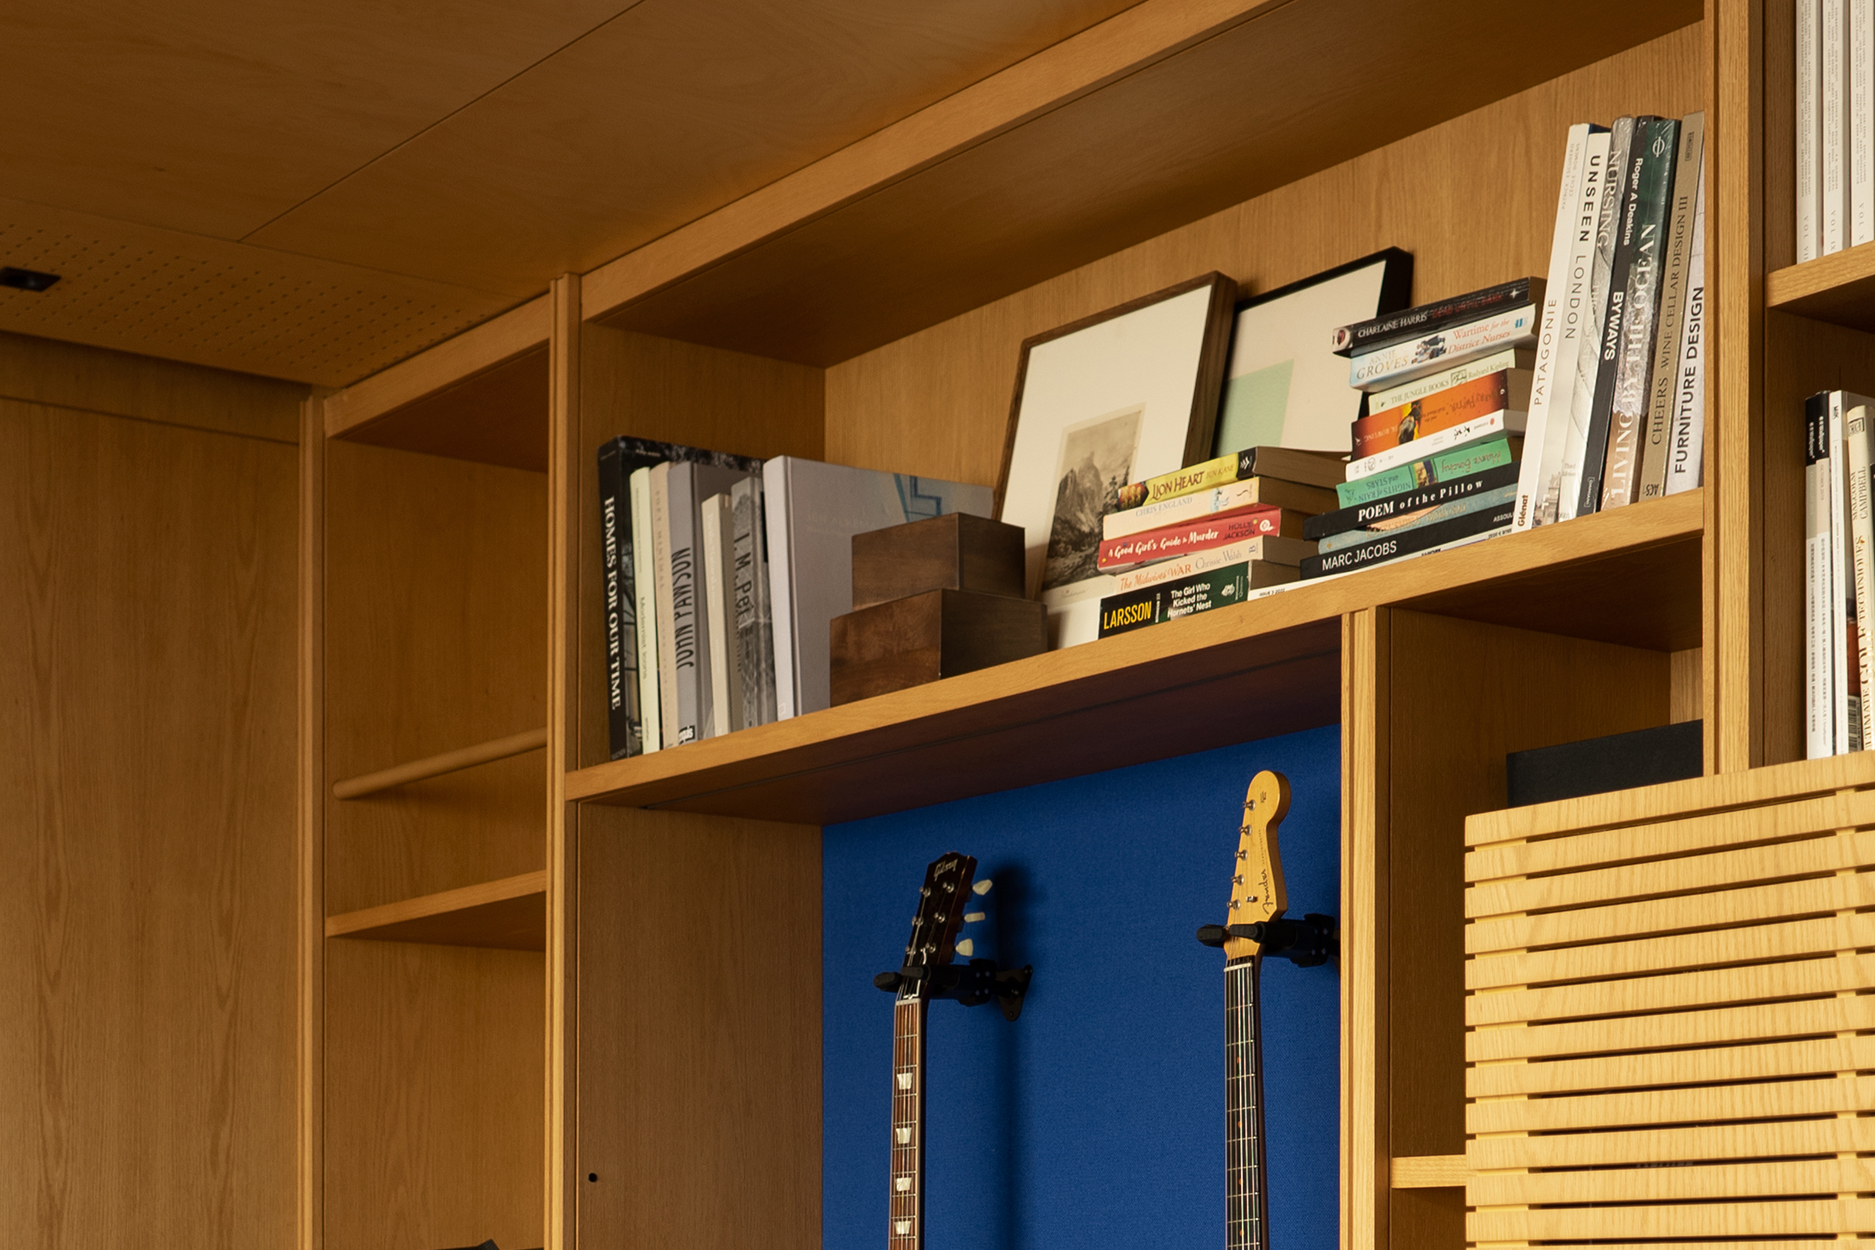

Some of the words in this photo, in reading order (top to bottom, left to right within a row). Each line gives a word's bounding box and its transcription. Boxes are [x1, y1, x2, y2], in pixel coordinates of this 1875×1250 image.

[1631, 158, 1643, 190] Roger
[1579, 155, 1601, 242] UNSEEN
[1597, 150, 1622, 247] NURSING
[1630, 192, 1638, 200] A
[1678, 196, 1688, 210] III
[1623, 203, 1637, 246] Deakins
[1672, 214, 1686, 267] DESIGN
[1565, 255, 1587, 339] LONDON
[1665, 271, 1679, 328] CELLAR
[1357, 318, 1399, 338] CHARLAINE
[1400, 312, 1427, 329] HARRIS
[1448, 338, 1481, 354] District
[1481, 330, 1511, 345] Nurses
[1452, 323, 1490, 340] Wartime
[1490, 321, 1500, 332] for
[1501, 318, 1511, 328] the
[1604, 291, 1624, 361] BYWAYS
[1356, 355, 1409, 380] GROVES
[1369, 350, 1397, 366] ANNIE
[1534, 299, 1558, 406] PATAGONIE
[1611, 412, 1635, 498] LIVING
[1633, 224, 1657, 309] OCEAN
[1660, 331, 1674, 369] WINE
[1390, 394, 1404, 404] THE
[1404, 386, 1427, 402] JUNGLE
[1427, 379, 1450, 395] BOOKS
[1468, 366, 1490, 380] Rudyard
[1490, 360, 1511, 375] Kipling
[1675, 366, 1696, 474] FURNITURE
[1686, 287, 1704, 360] DESIGN
[1152, 480, 1173, 500] LION
[1174, 471, 1205, 493] HEART
[1218, 464, 1234, 477] KANE
[1358, 489, 1377, 502] RAIN
[1366, 477, 1388, 491] STARS
[1384, 481, 1411, 496] NIGHTS
[1387, 475, 1399, 486] and
[1858, 466, 1868, 519] CAMPBELL
[1136, 506, 1157, 517] CHRIS
[1158, 497, 1193, 513] ENGLAND
[1357, 501, 1395, 522] POEM
[1399, 499, 1412, 510] of
[1416, 493, 1436, 506] the
[1440, 480, 1484, 499] Pillow
[1518, 494, 1529, 527] Glénat
[605, 496, 618, 569] HOMES
[1114, 543, 1134, 559] Good
[1135, 538, 1158, 555] Girl's
[1187, 528, 1220, 547] Murder
[1224, 529, 1256, 542] JACKSON
[1228, 521, 1252, 532] HOLLY
[1322, 552, 1352, 571] MARC
[1354, 540, 1397, 563] JACOBS
[608, 569, 619, 610] FOR
[671, 547, 693, 621] PAWSON
[1119, 578, 1133, 591] The
[1169, 563, 1192, 580] WAR
[1171, 589, 1182, 600] The
[1183, 585, 1194, 597] Girl
[1195, 582, 1211, 594] Who
[1855, 535, 1866, 622] TECHNIQUES
[736, 580, 755, 617] Pei
[1103, 601, 1152, 630] LARSSON
[1167, 604, 1195, 619] Hornets'
[1195, 600, 1212, 612] Nest
[1172, 595, 1196, 608] Kicked
[1196, 592, 1208, 603] the
[609, 611, 620, 656] OUR
[676, 623, 694, 671] JOHN
[611, 656, 621, 711] TIME
[1258, 868, 1274, 915] Fender
